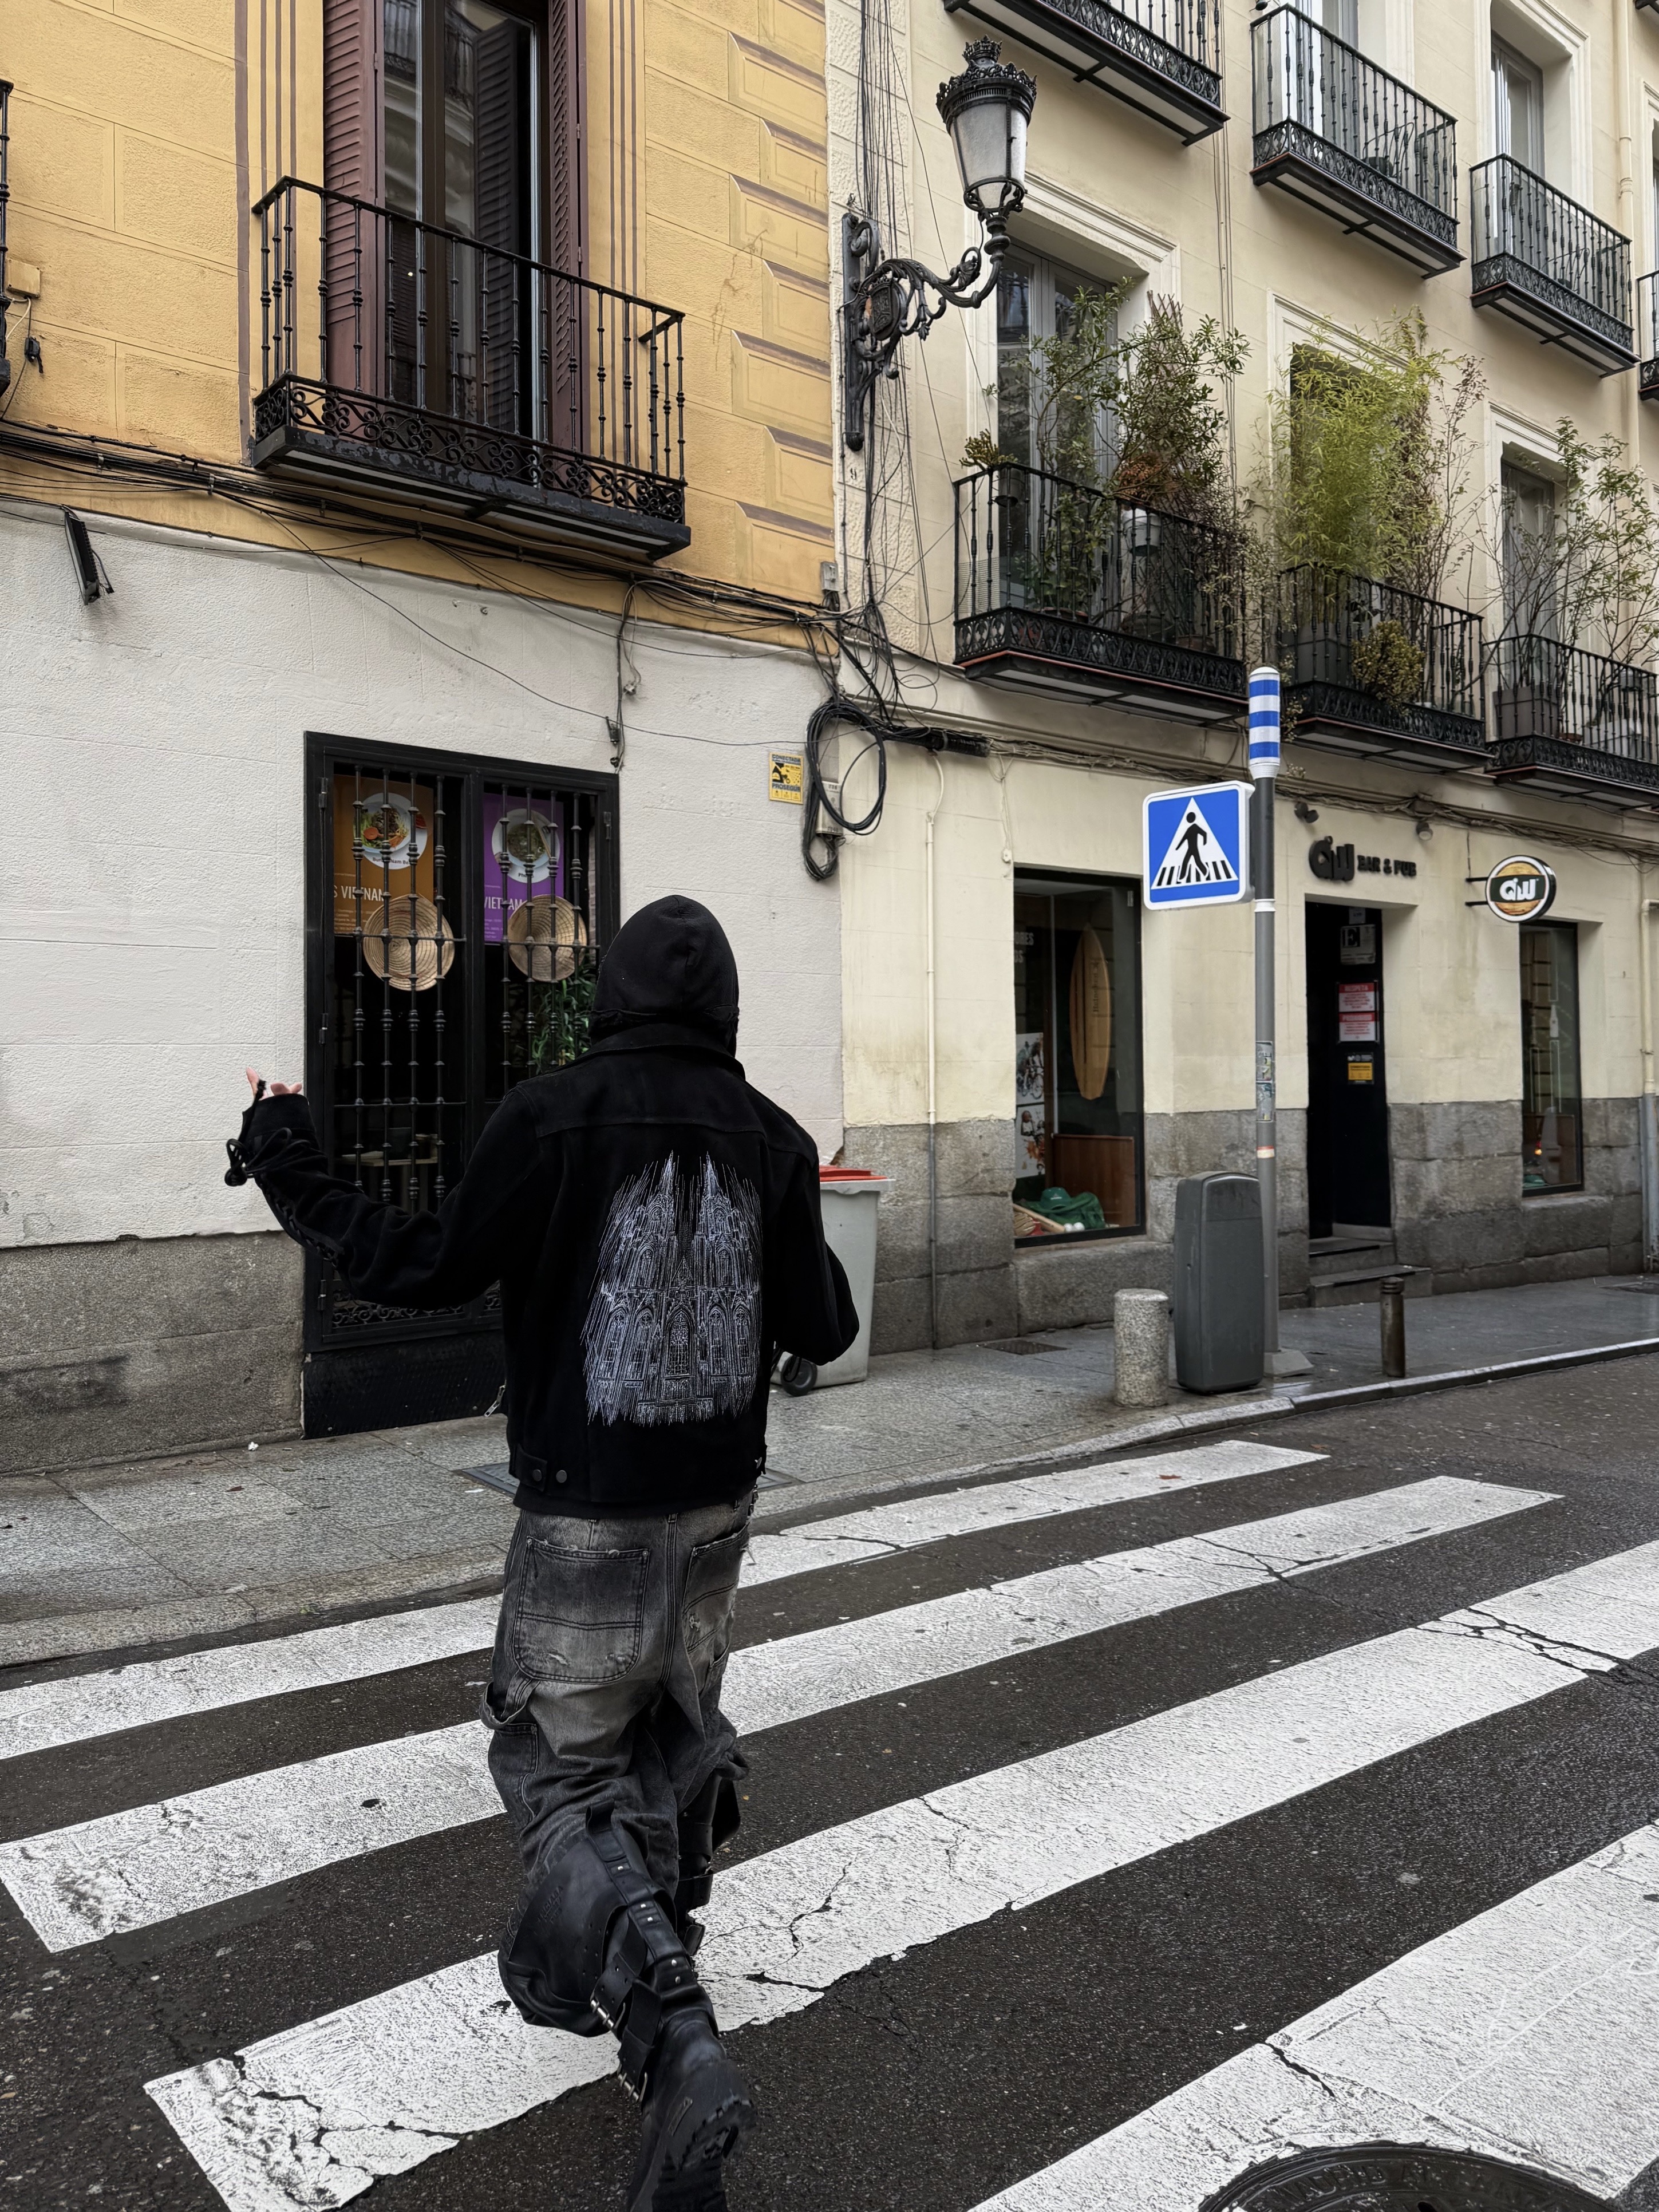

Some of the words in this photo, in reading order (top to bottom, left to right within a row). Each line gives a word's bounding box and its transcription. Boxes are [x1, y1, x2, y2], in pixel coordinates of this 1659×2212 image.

[1357, 855, 1381, 872] BAR
[1383, 858, 1392, 874] &
[1393, 860, 1417, 878] PUB
[484, 896, 523, 910] IETAM
